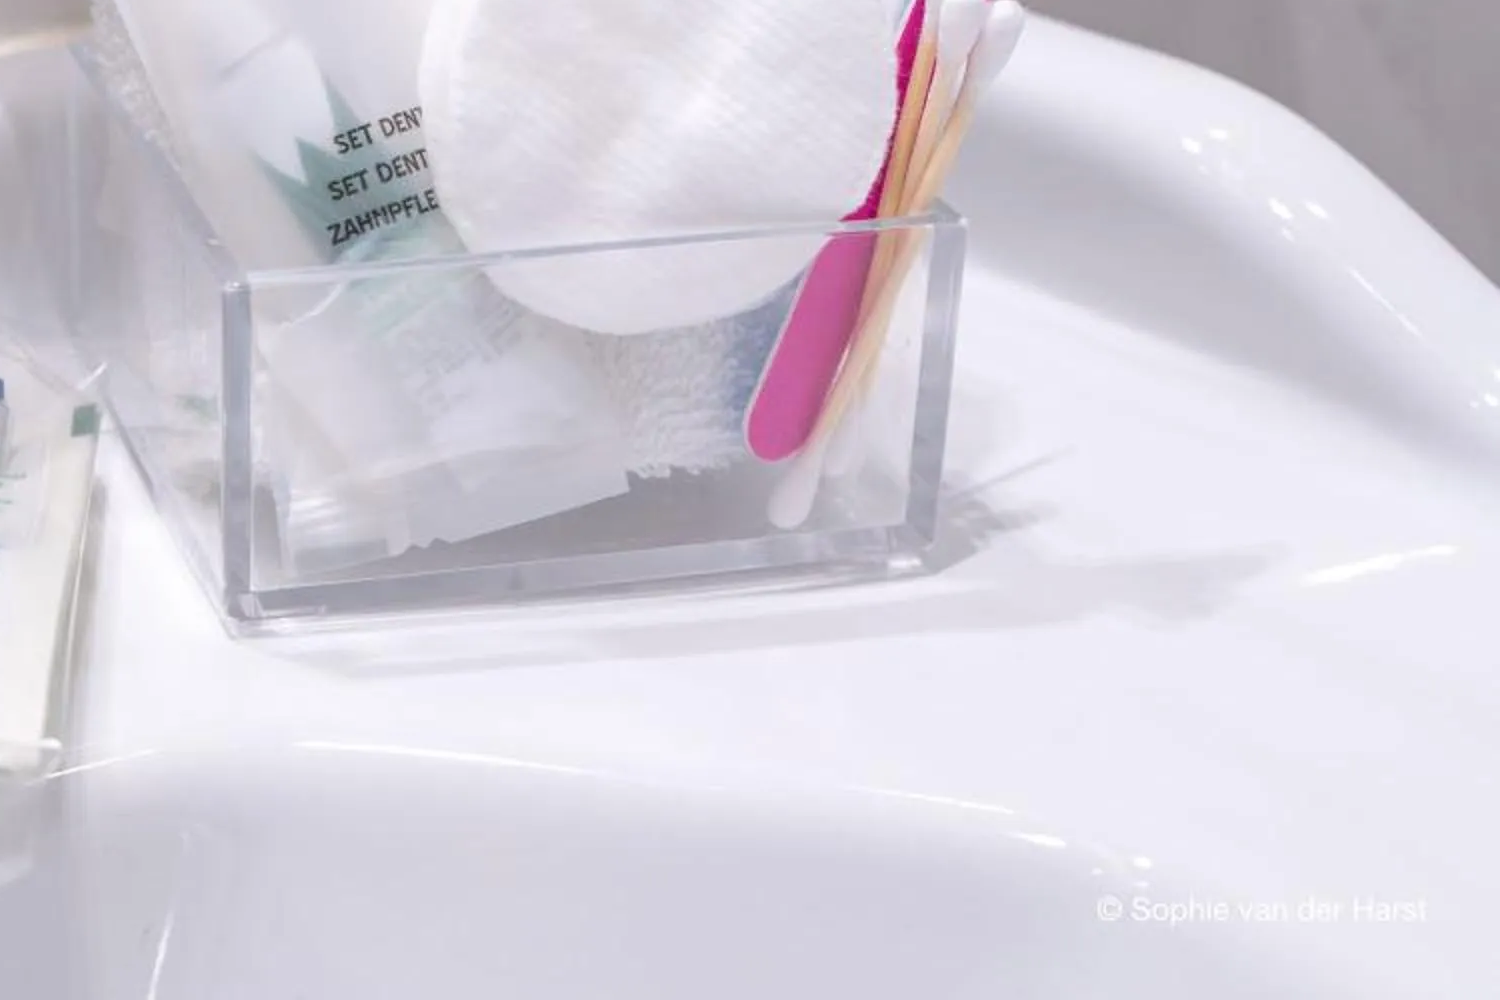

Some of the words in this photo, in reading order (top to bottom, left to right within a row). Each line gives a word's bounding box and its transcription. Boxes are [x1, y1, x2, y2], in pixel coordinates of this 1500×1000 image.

[334, 123, 374, 154] SET
[327, 168, 370, 201] SET
[376, 148, 428, 184] DENT
